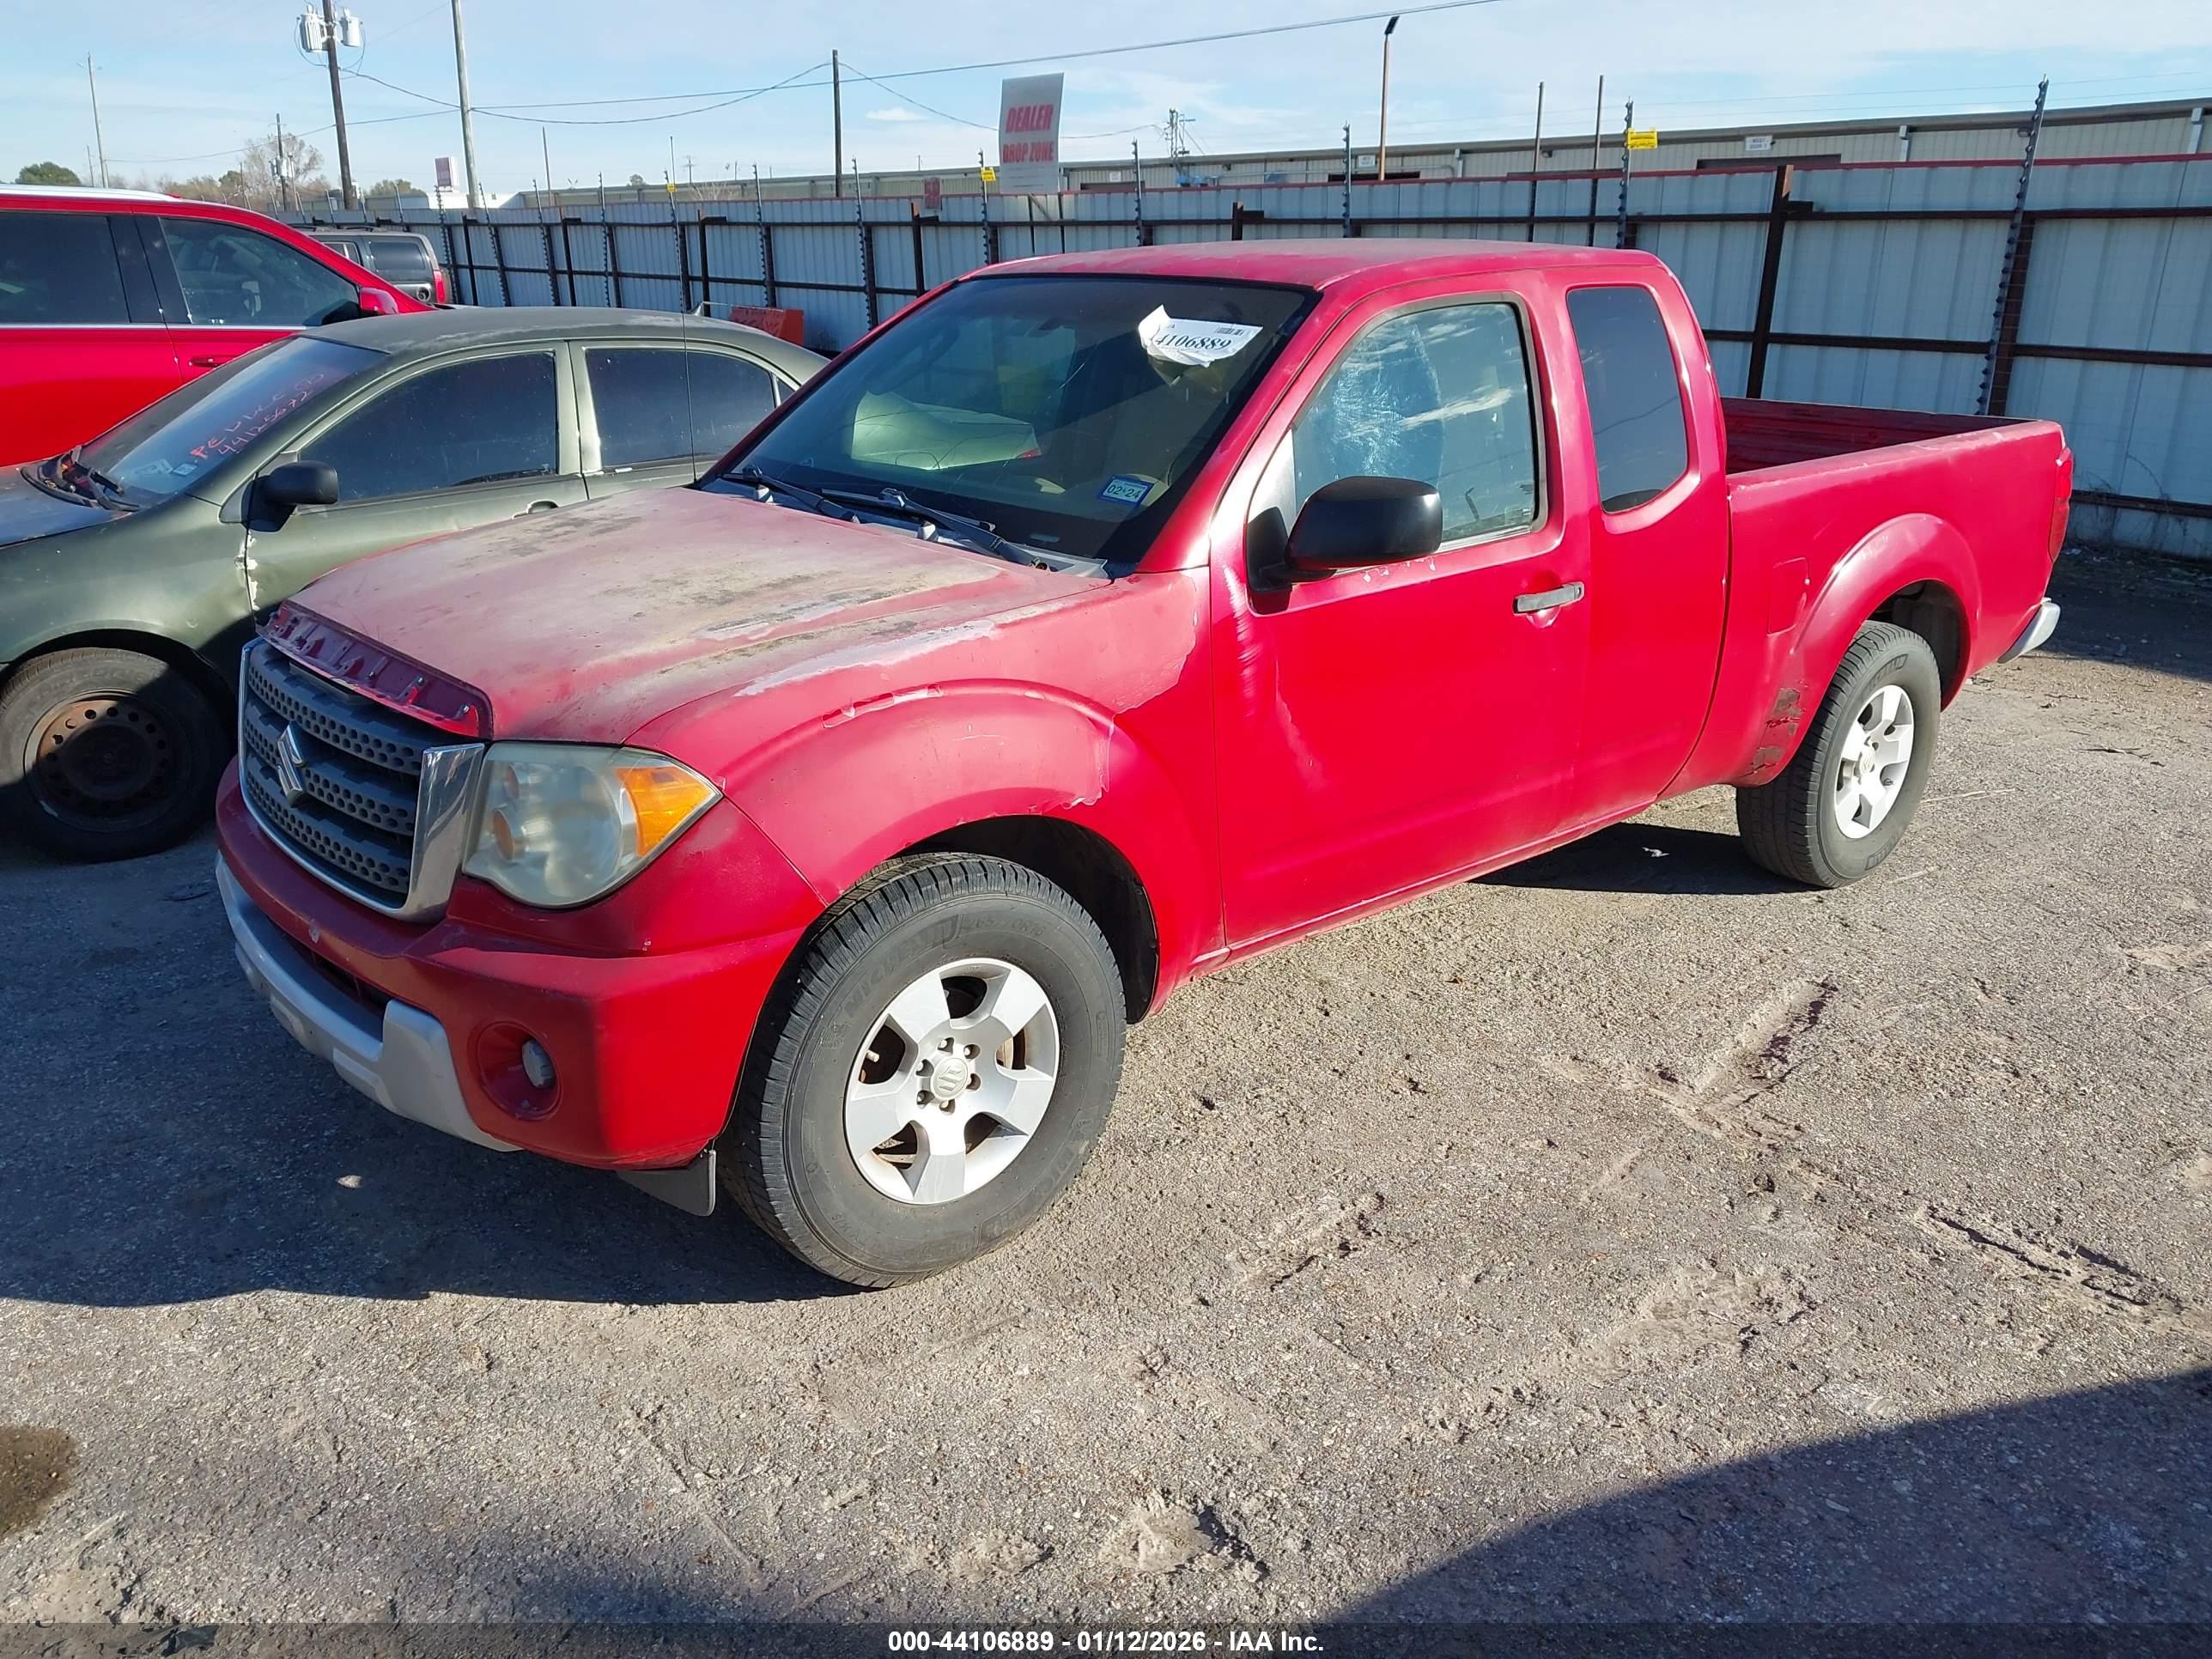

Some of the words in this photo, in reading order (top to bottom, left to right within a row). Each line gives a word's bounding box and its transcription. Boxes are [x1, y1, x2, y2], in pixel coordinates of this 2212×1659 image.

[1005, 104, 1053, 132] DEALER
[1003, 142, 1029, 164] DROP
[1030, 141, 1054, 162] ZONE
